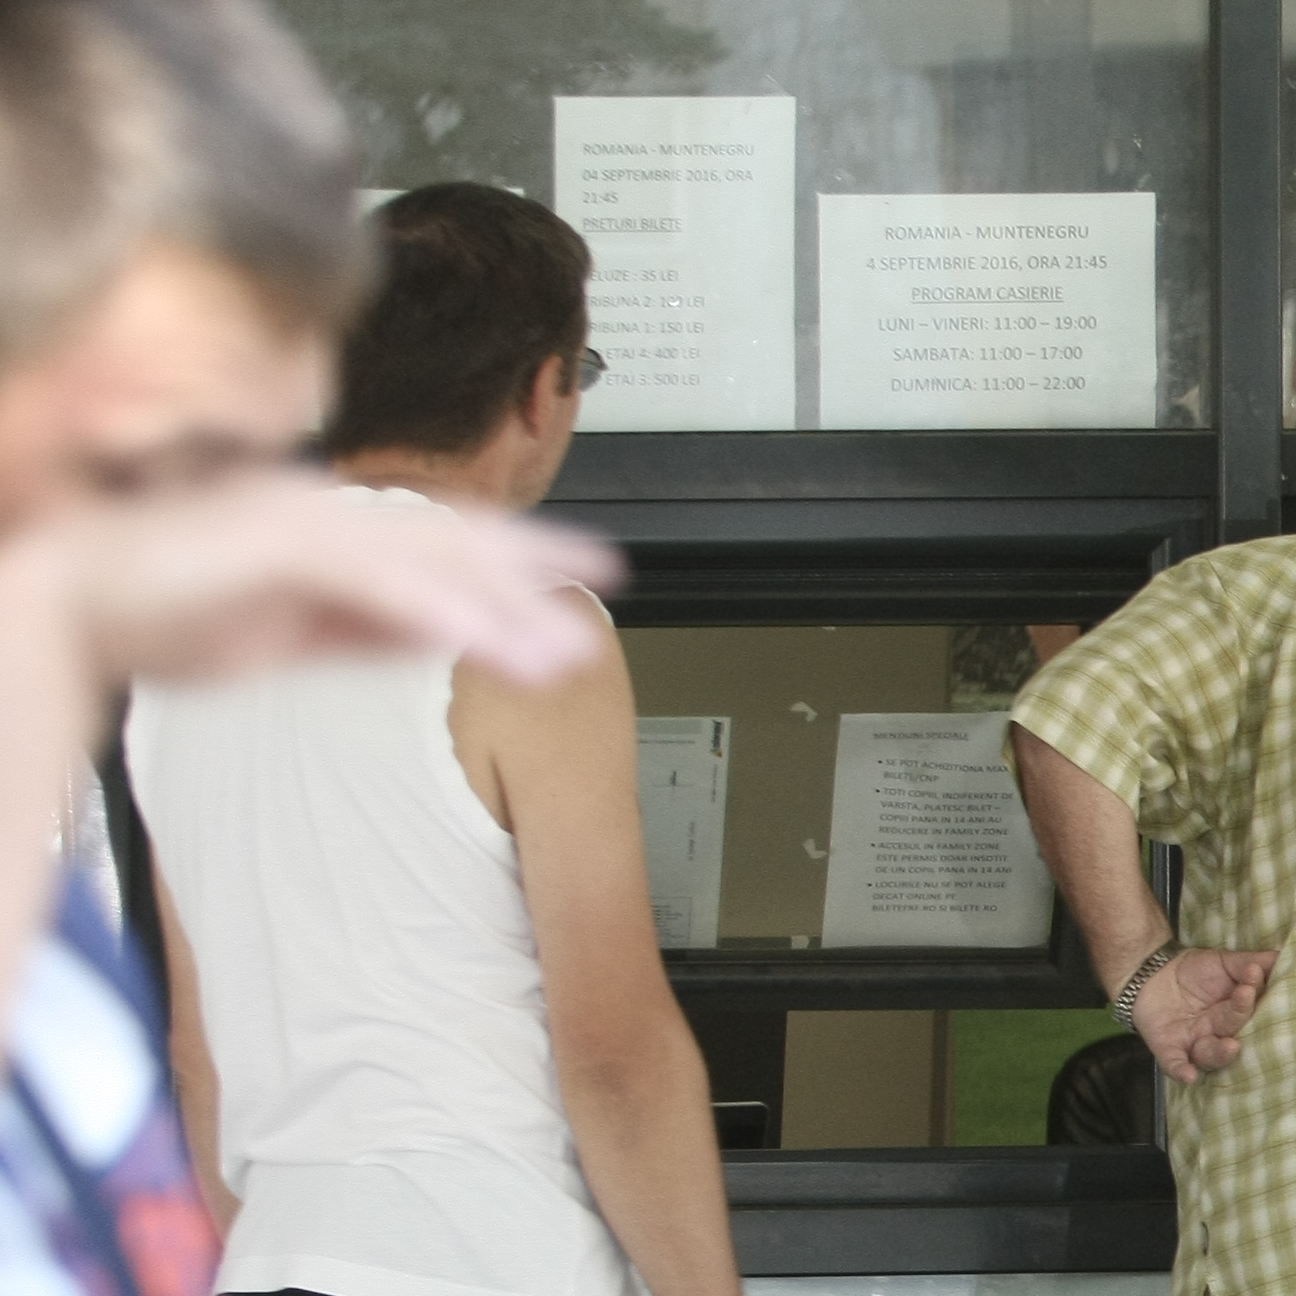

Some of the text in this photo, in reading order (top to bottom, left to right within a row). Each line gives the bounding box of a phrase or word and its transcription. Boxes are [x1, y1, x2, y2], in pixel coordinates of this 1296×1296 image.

[583, 144, 755, 156] ROMANIA MUNTENEGRU
[582, 192, 619, 205] 21:45
[582, 218, 683, 230] PRETURI BILETE
[884, 225, 1090, 241] ROMANIA MUNTENEGRU
[865, 256, 1108, 272] 4 SEPTEMBRIE 2016, ORA 21:45
[590, 270, 629, 282] ELUZE
[911, 287, 1064, 302] PROGRAM CASIERIE
[589, 296, 641, 308] RIBUNA
[589, 322, 640, 334] RIBUNA
[877, 316, 1098, 332] LUNI VINERI: 11:00 19:00
[892, 347, 1083, 362] SAMBATA: 11:00 17:00
[890, 377, 1086, 392] DUMINICA: 11:00 22:00
